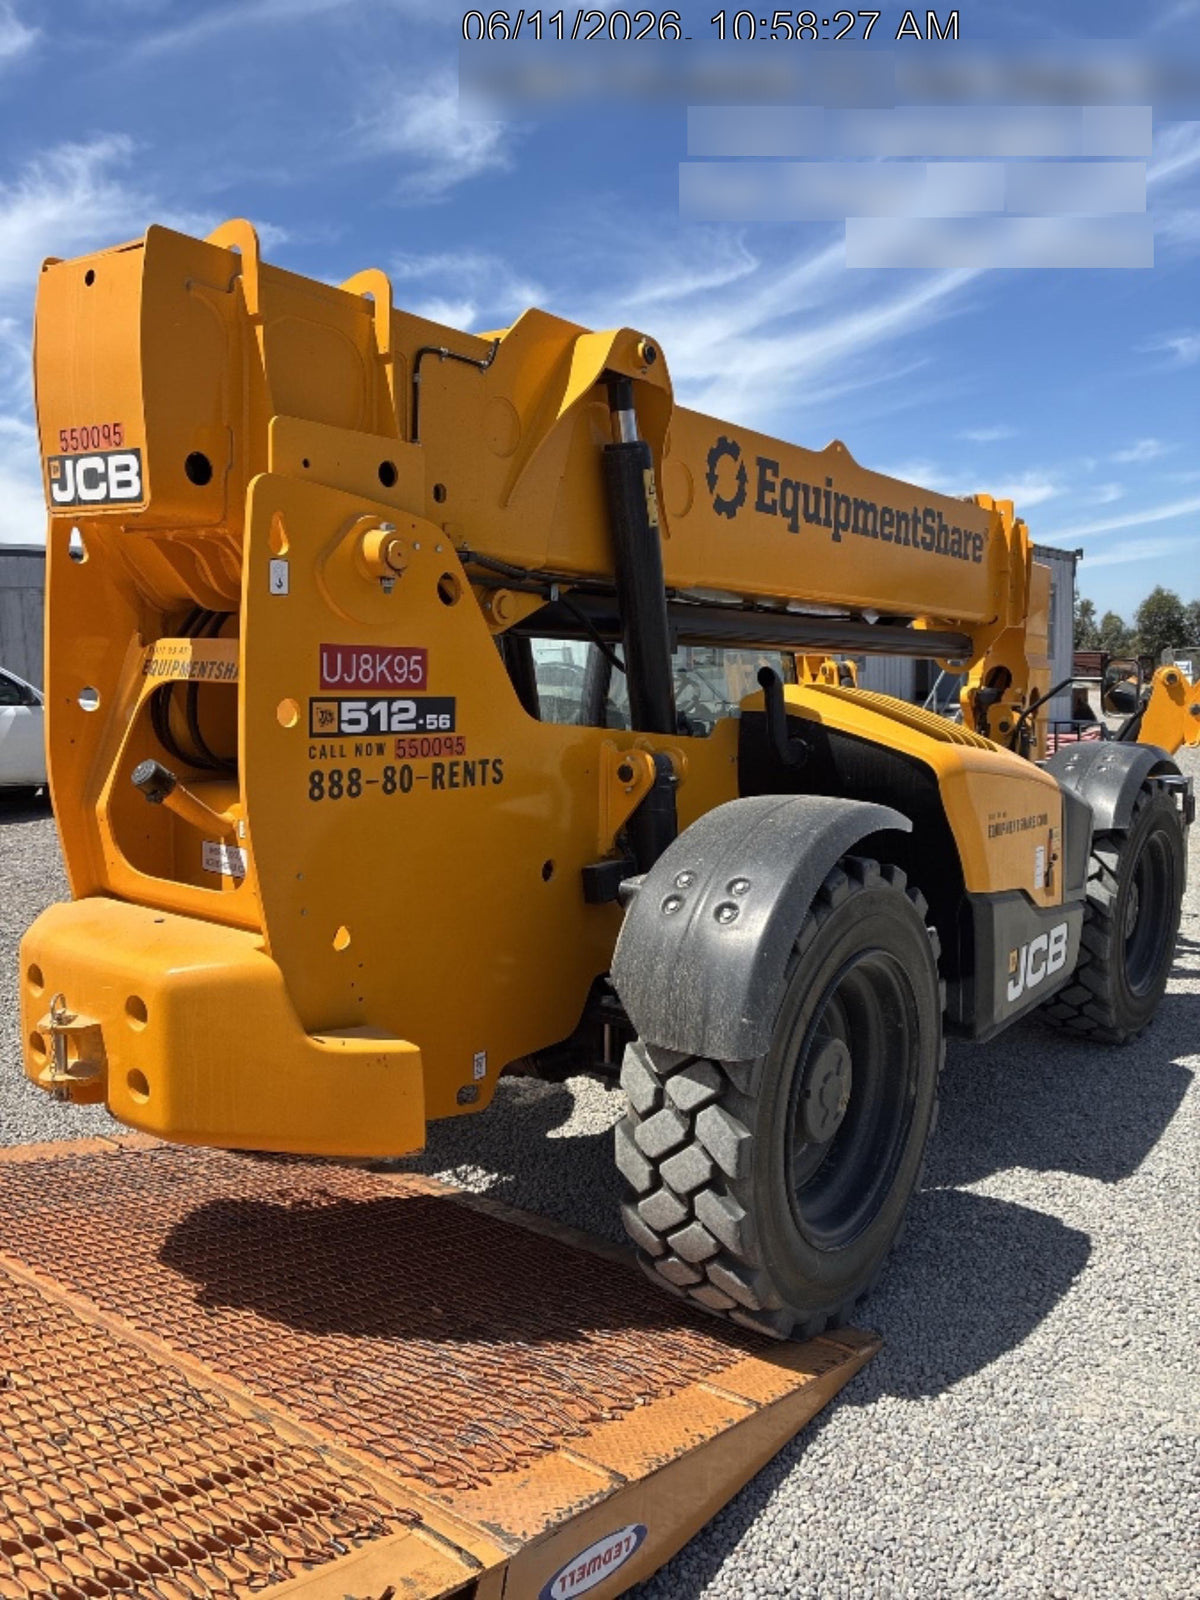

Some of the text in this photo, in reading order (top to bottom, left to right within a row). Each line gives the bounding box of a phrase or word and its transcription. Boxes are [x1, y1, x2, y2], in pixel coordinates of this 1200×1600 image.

[59, 423, 123, 452] 550095
[51, 454, 141, 503] JCB
[755, 456, 984, 564] EquipmentShare
[322, 652, 424, 684] UJ8K95
[308, 742, 386, 760] CALL NOW
[395, 737, 466, 760] 550095
[308, 759, 504, 802] 888-80-RENTS
[1007, 922, 1068, 1002] JCB
[559, 1535, 632, 1593] LEDWELL
